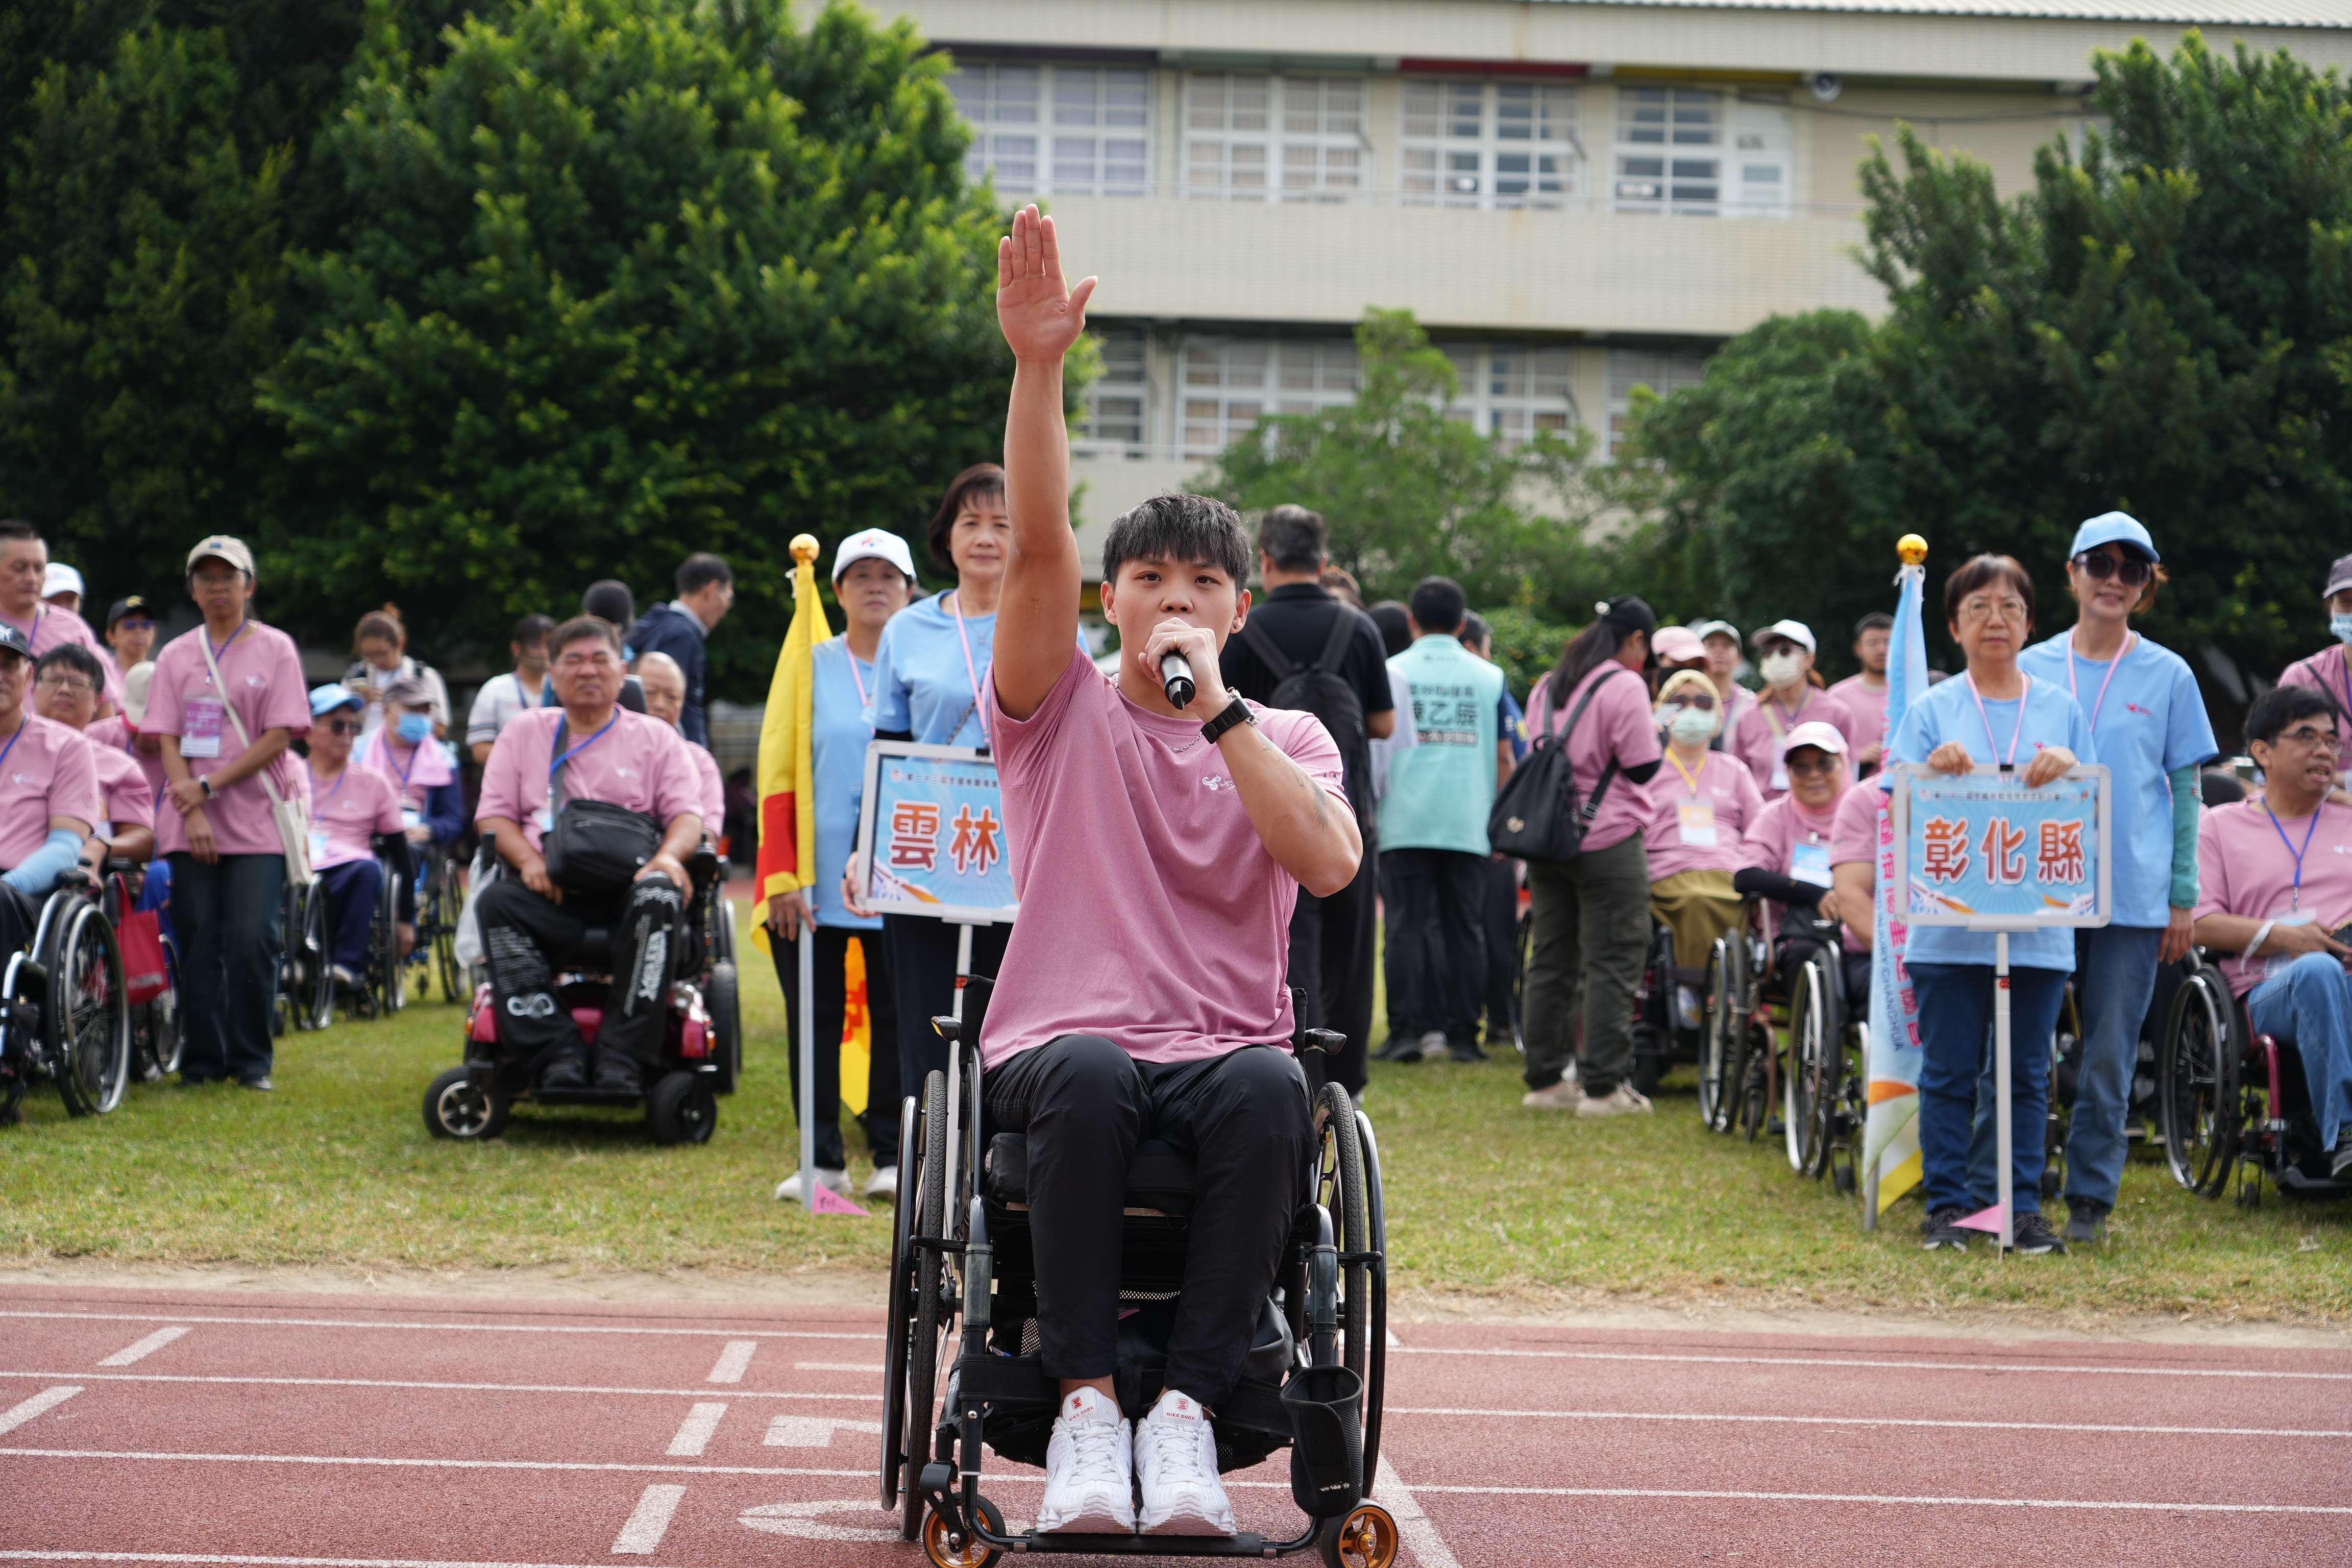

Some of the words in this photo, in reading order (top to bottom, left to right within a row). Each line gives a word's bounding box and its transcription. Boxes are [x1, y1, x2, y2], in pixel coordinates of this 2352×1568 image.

[890, 802, 999, 873] 雲林
[1924, 818, 2084, 883] 彰化縣
[1882, 967, 1904, 1052] CHANGHUA
[1069, 1413, 1080, 1422] NIKE
[1080, 1406, 1094, 1415] SHOX
